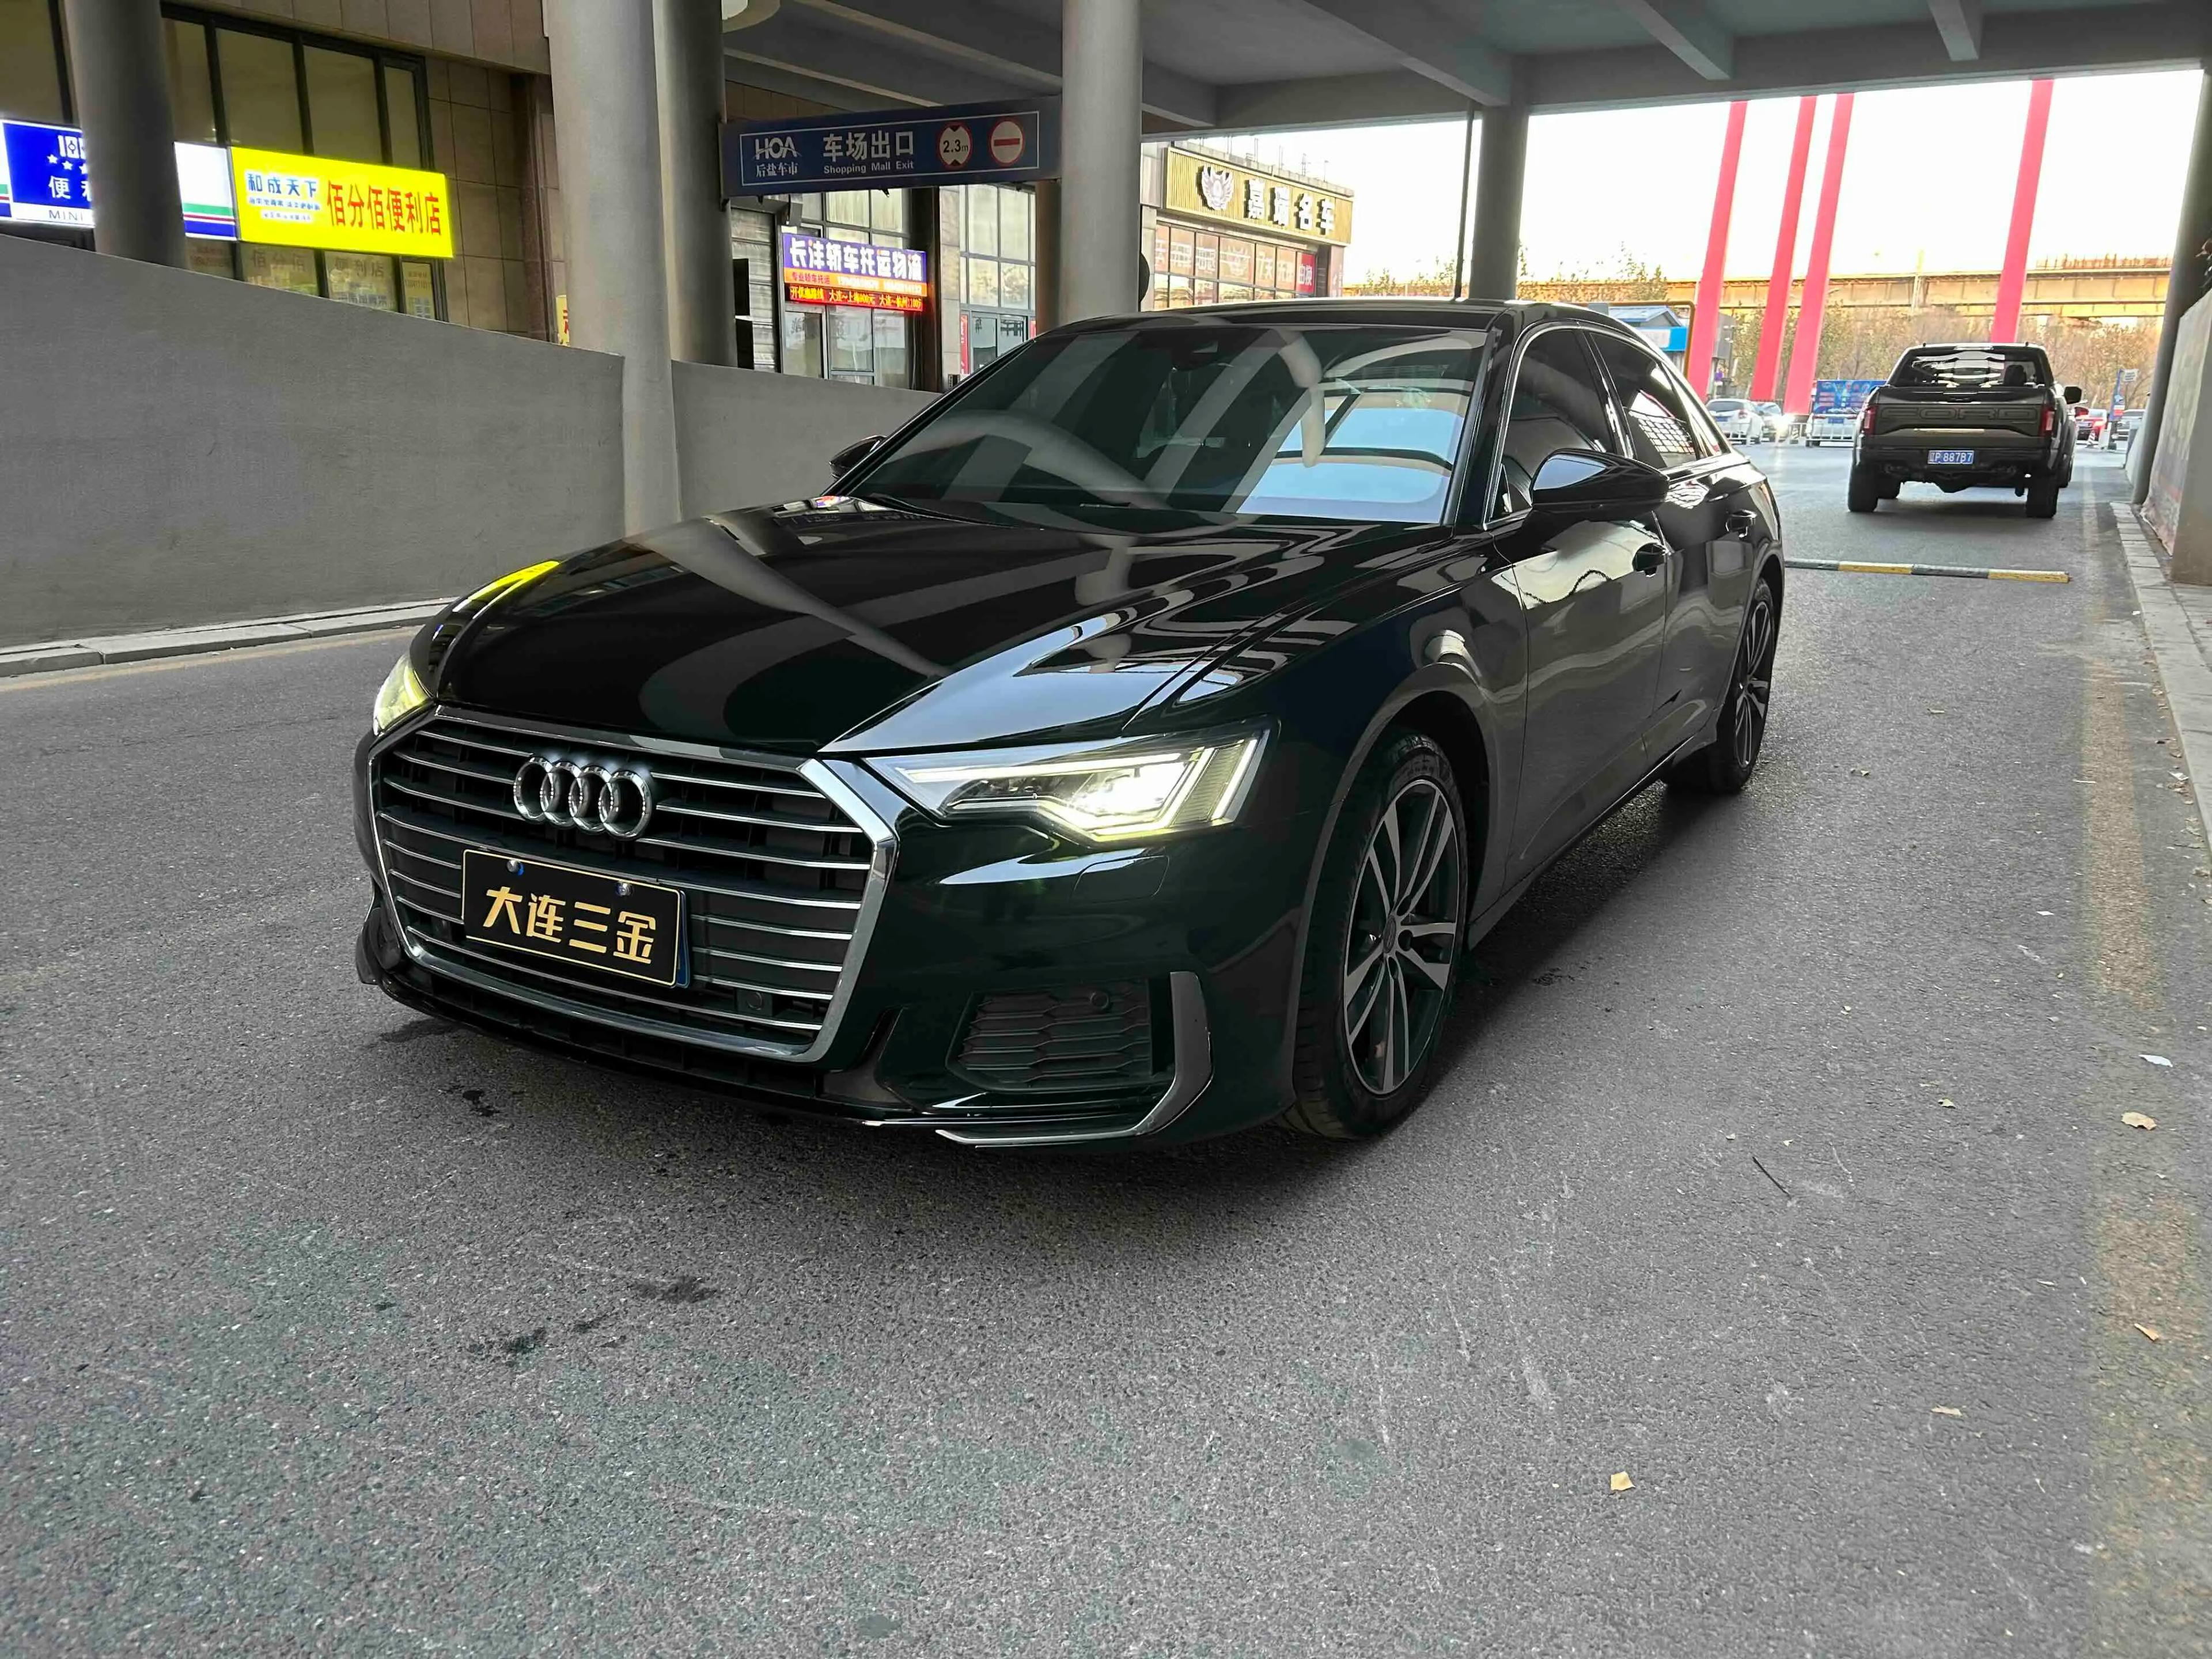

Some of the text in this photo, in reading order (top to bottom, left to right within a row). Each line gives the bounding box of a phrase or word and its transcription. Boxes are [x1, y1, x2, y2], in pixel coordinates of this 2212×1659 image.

[755, 136, 798, 160] HOA
[823, 130, 914, 162] 车场出口
[943, 139, 969, 153] 2.3m
[756, 161, 798, 177] 后盐车市
[824, 160, 914, 175] Shopping Mall Exit
[247, 173, 316, 198] 和成天下
[327, 180, 442, 236] 佰分佰便利店
[1881, 407, 2037, 420] FORD
[482, 885, 658, 965] 大连三金
